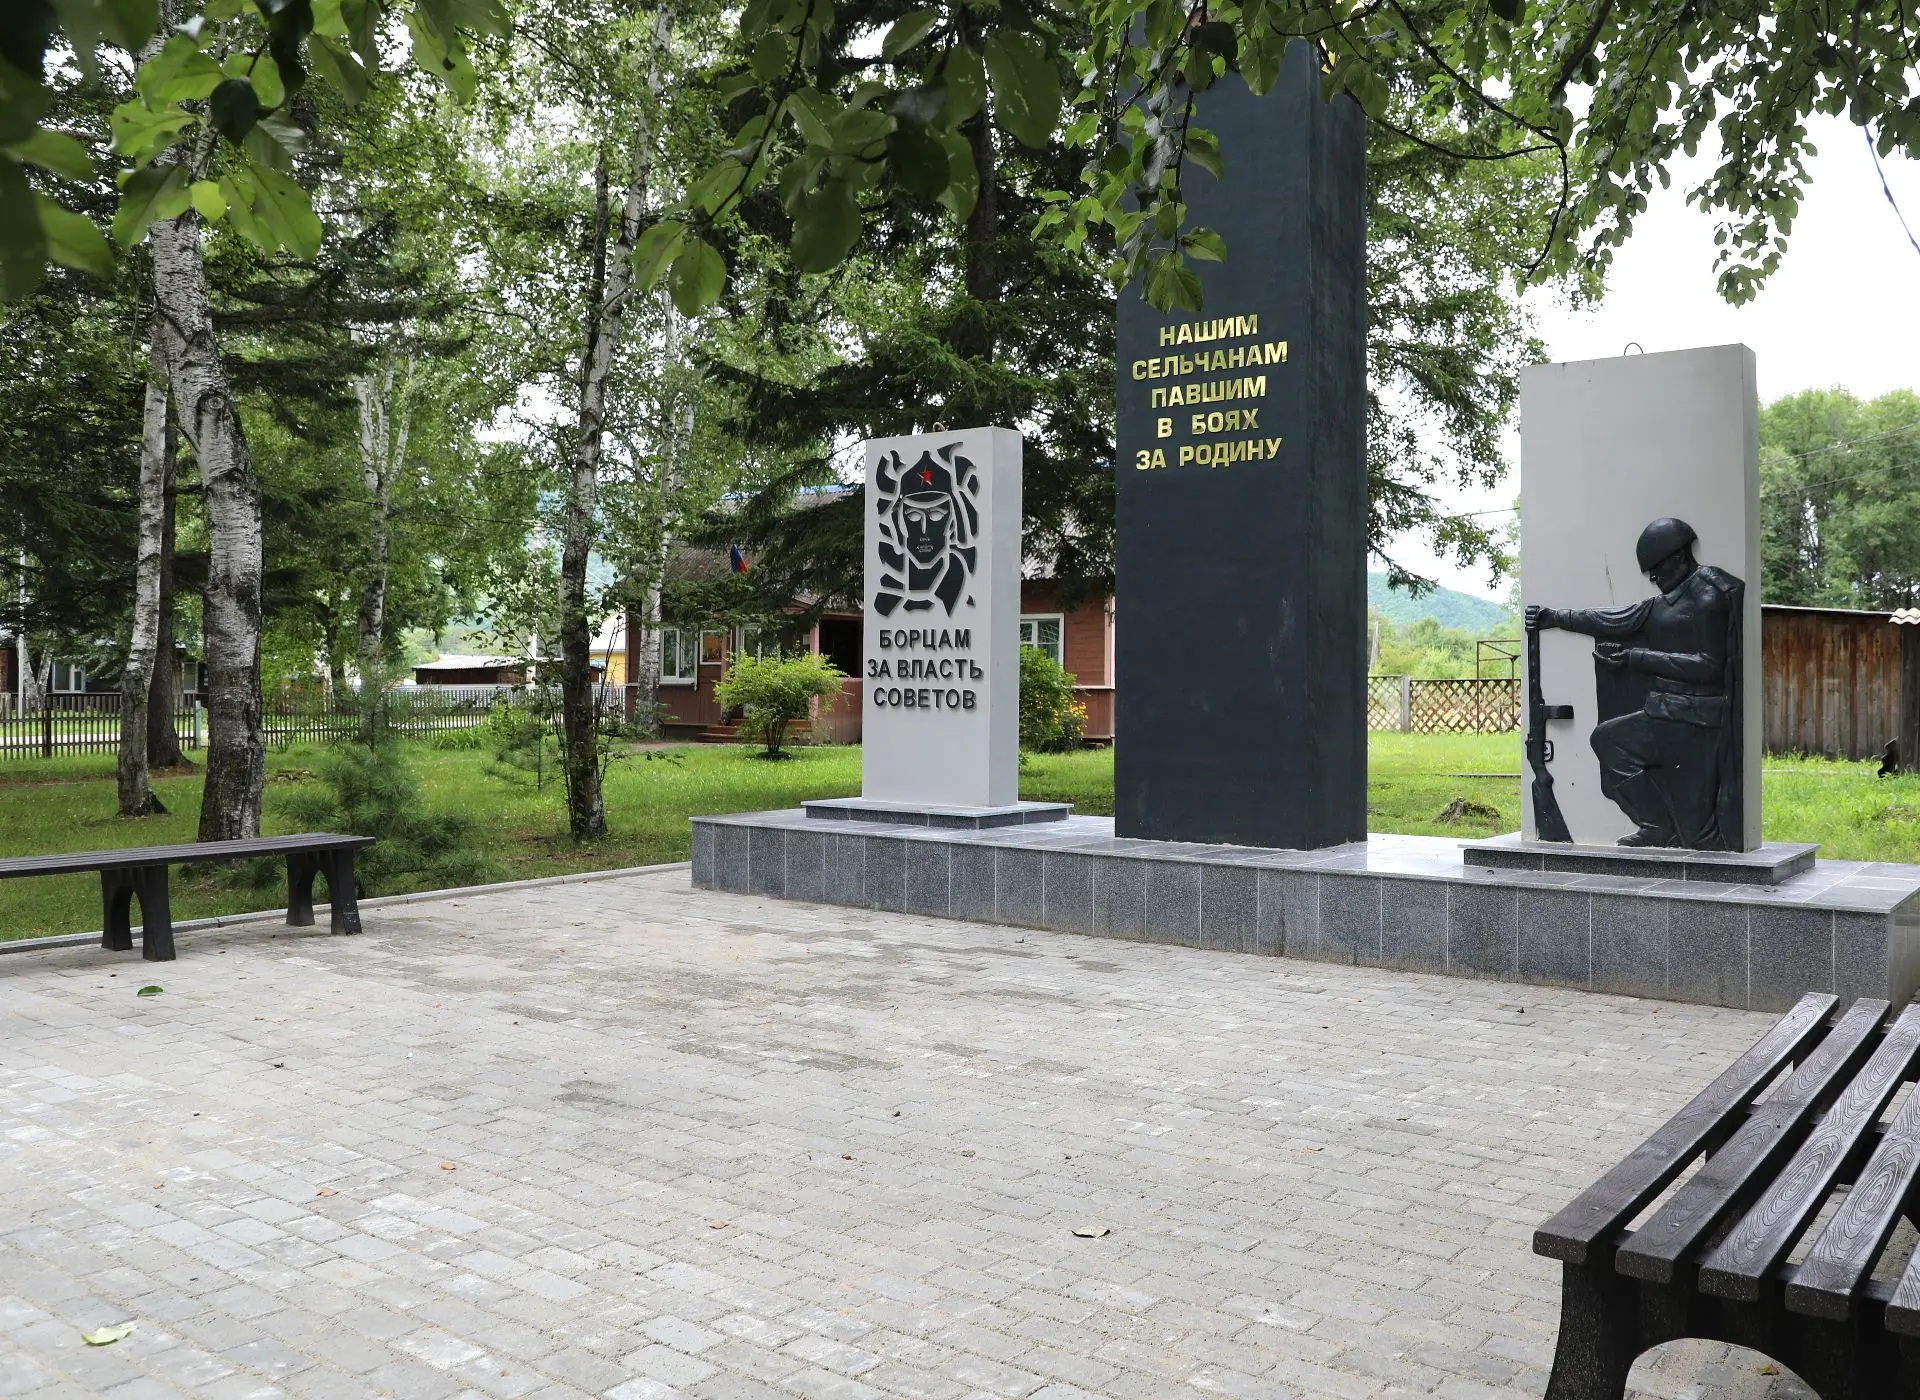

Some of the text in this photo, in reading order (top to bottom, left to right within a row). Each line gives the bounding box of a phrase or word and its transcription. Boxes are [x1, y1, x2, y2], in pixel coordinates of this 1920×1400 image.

[1159, 314, 1258, 347] НАШИМ
[1132, 341, 1288, 380] СЕЛЬЧАНАМ
[1151, 376, 1267, 409] ПАВШИМ
[1157, 408, 1259, 438] В БОЯХ
[1135, 437, 1283, 470] ЗА РОДИНУ
[879, 629, 971, 650] БОРЦАМ
[867, 659, 983, 679] ЗА ВЛАСТЬ
[873, 687, 976, 709] СОВЕТОВ
